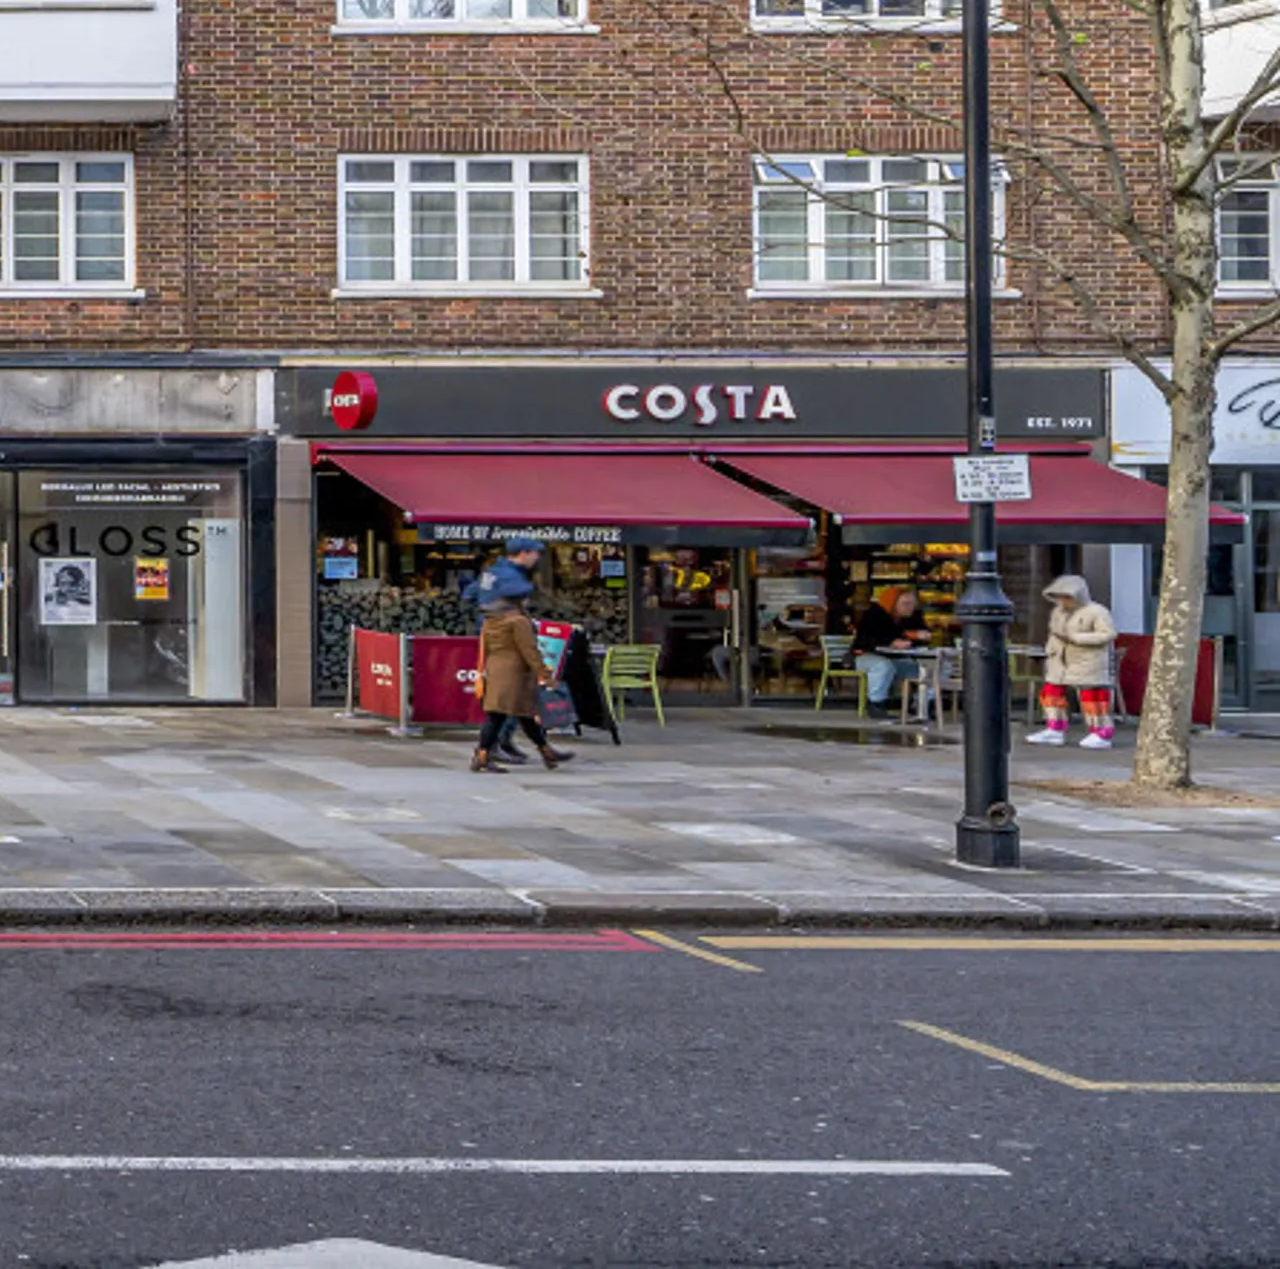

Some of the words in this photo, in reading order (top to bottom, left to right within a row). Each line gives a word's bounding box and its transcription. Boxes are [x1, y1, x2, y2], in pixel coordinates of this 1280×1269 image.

[603, 383, 796, 425] COSTA
[1061, 418, 1092, 428] 1971
[30, 523, 200, 556] GLOSS
[574, 528, 621, 542] COFFEE
